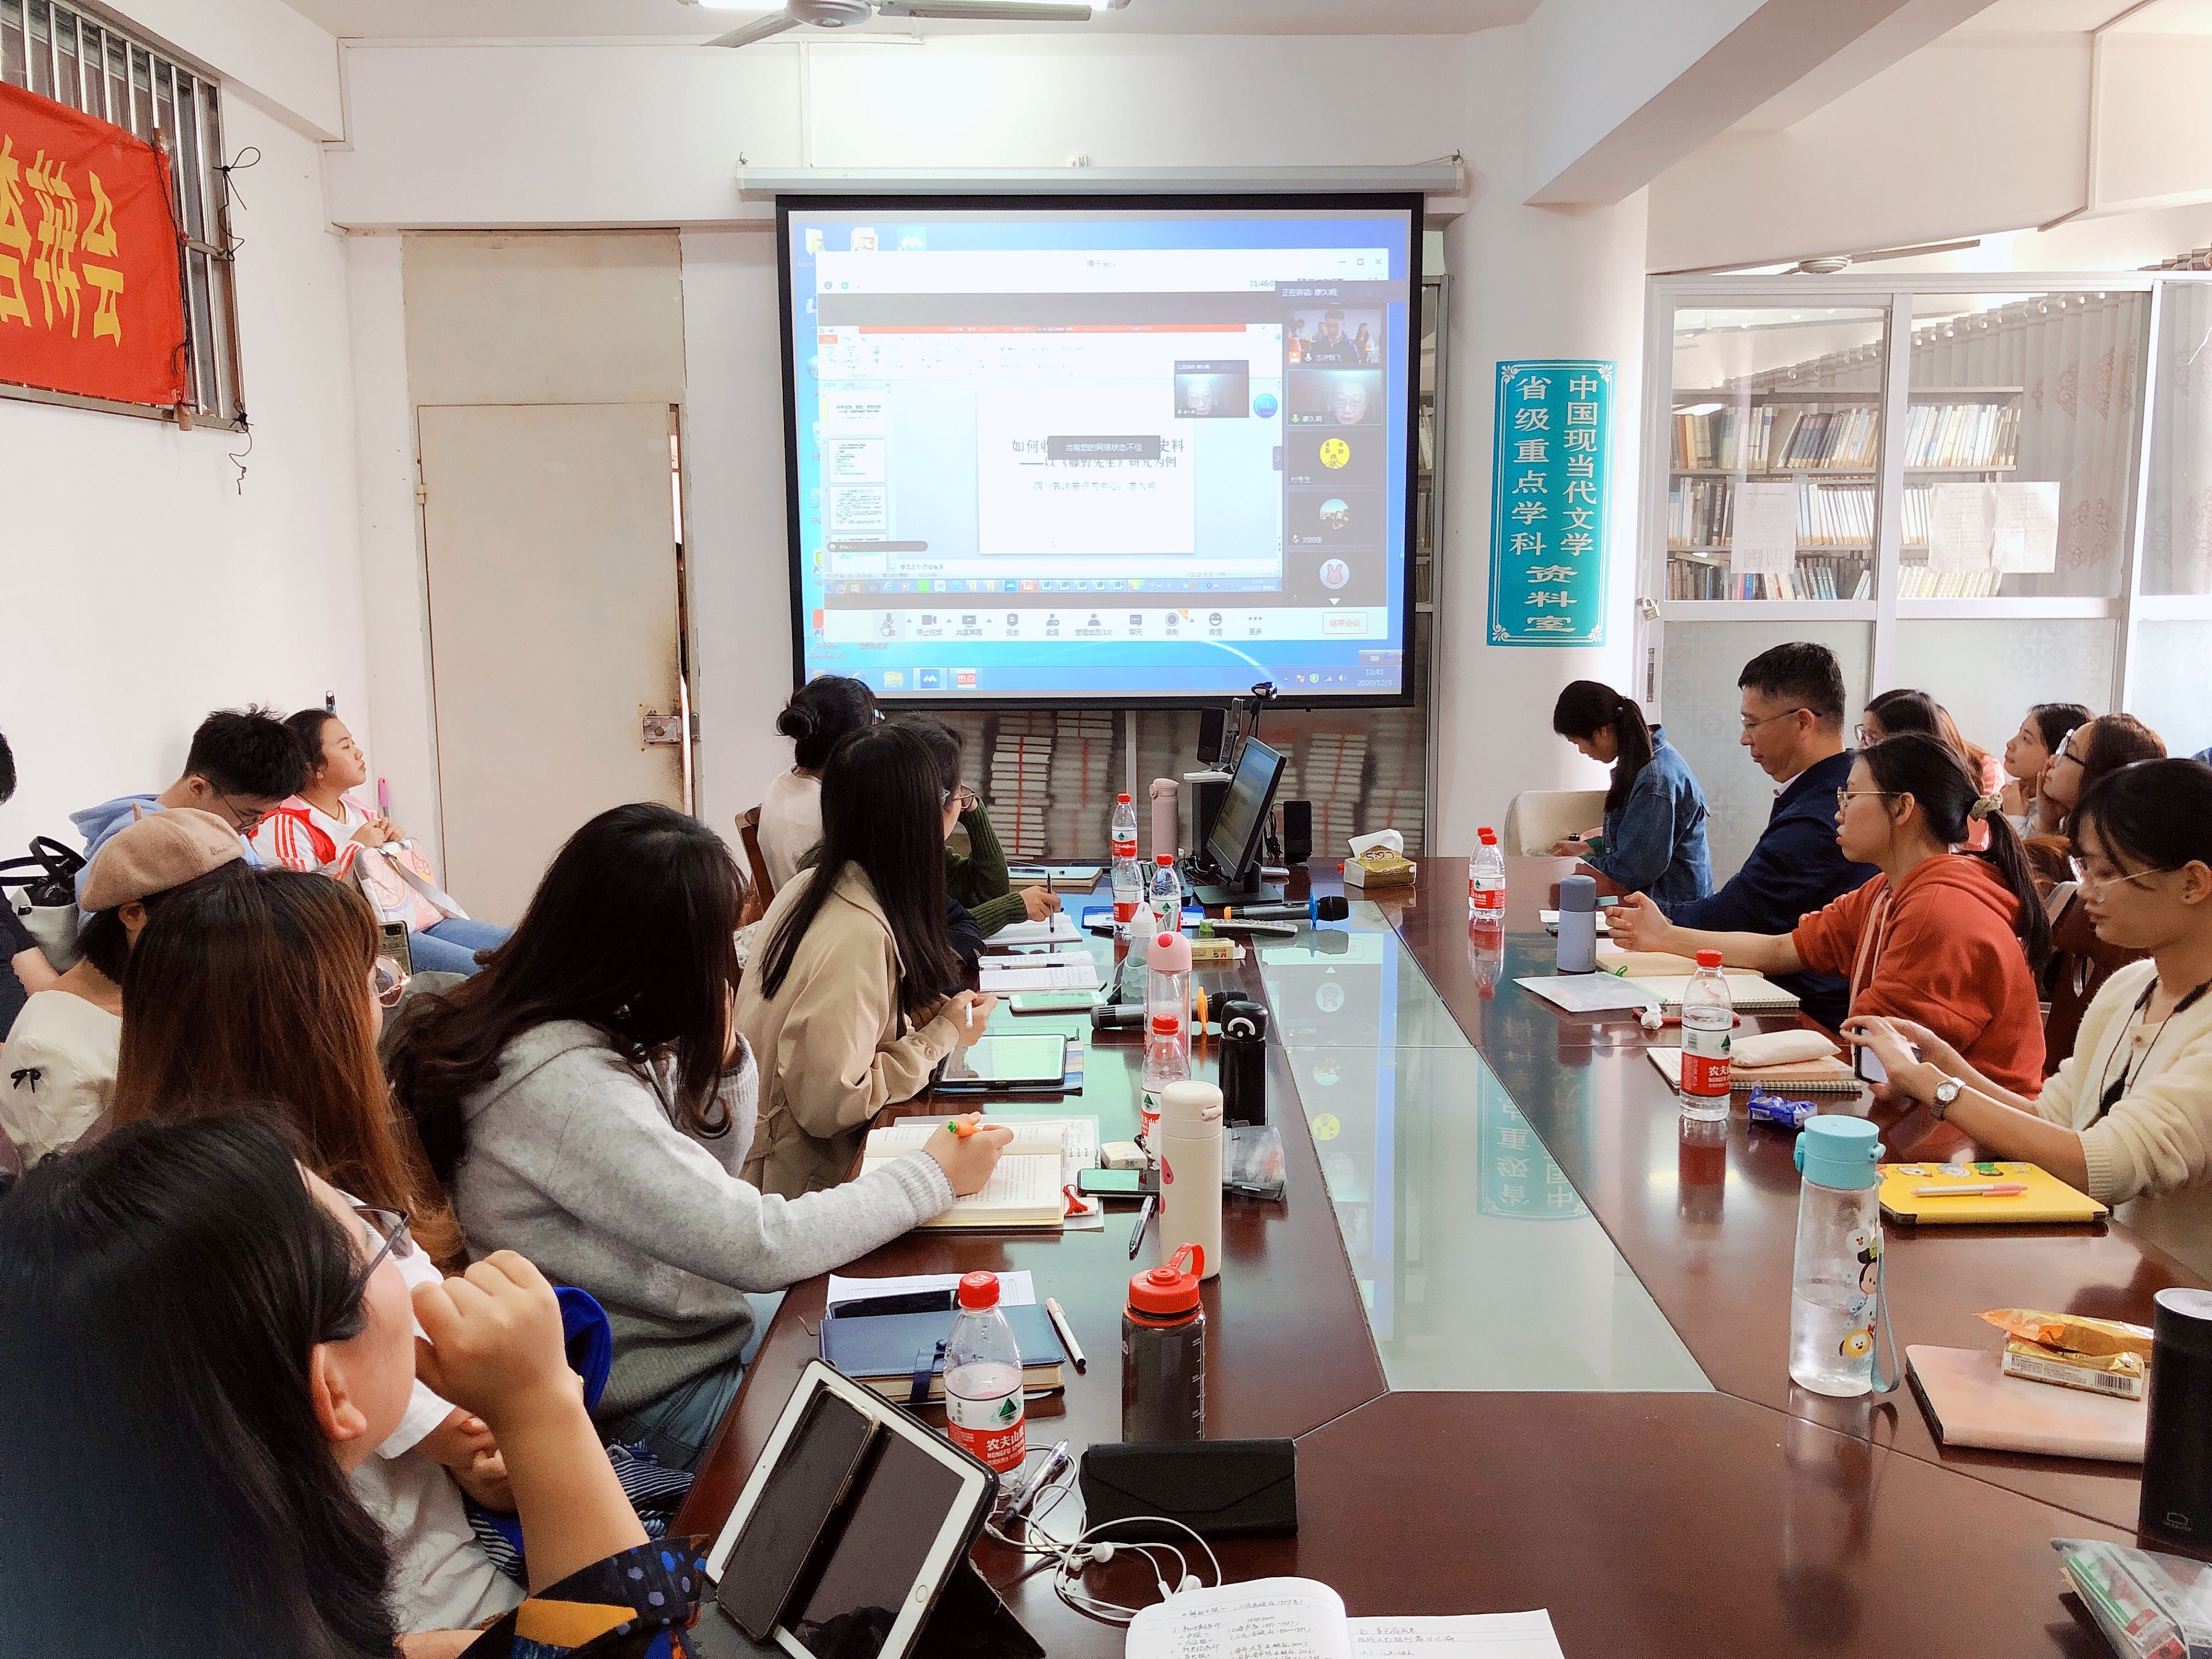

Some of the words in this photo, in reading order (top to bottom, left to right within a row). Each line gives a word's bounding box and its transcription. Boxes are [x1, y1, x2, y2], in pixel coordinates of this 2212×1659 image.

[1066, 443, 1143, 452] 当前您的网络状态不佳
[1508, 375, 1552, 556] 省级重点学科
[1559, 374, 1599, 557] 中国现当代文学
[1523, 565, 1578, 633] 资料室
[1329, 619, 1361, 627] 结束会议
[1357, 679, 1392, 687] 2020/12/3
[987, 1448, 1011, 1459] NONGFU
